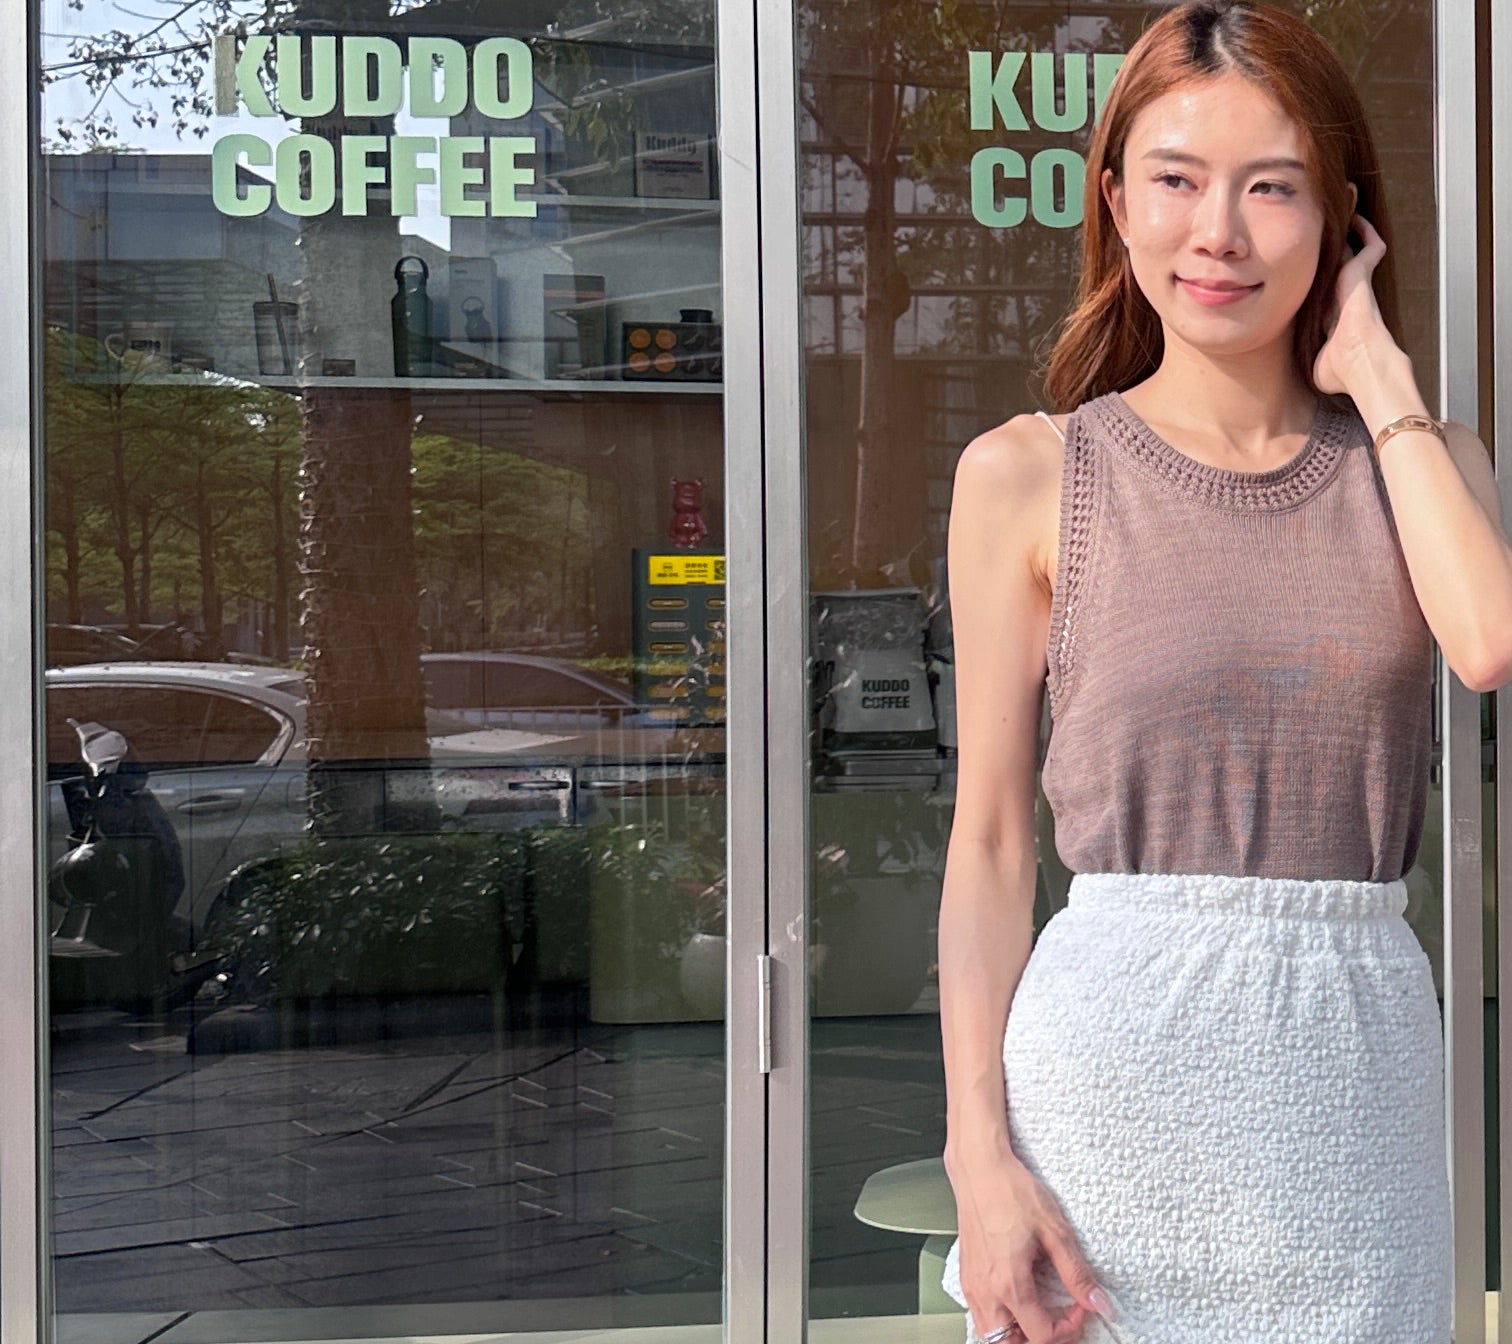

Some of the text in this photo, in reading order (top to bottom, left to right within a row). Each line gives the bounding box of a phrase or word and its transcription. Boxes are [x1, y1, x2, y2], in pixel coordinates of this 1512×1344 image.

[214, 36, 534, 118] KUDDO
[212, 134, 538, 218] COFFEE
[861, 679, 910, 693] KUDDO
[861, 696, 911, 709] COFFEE
